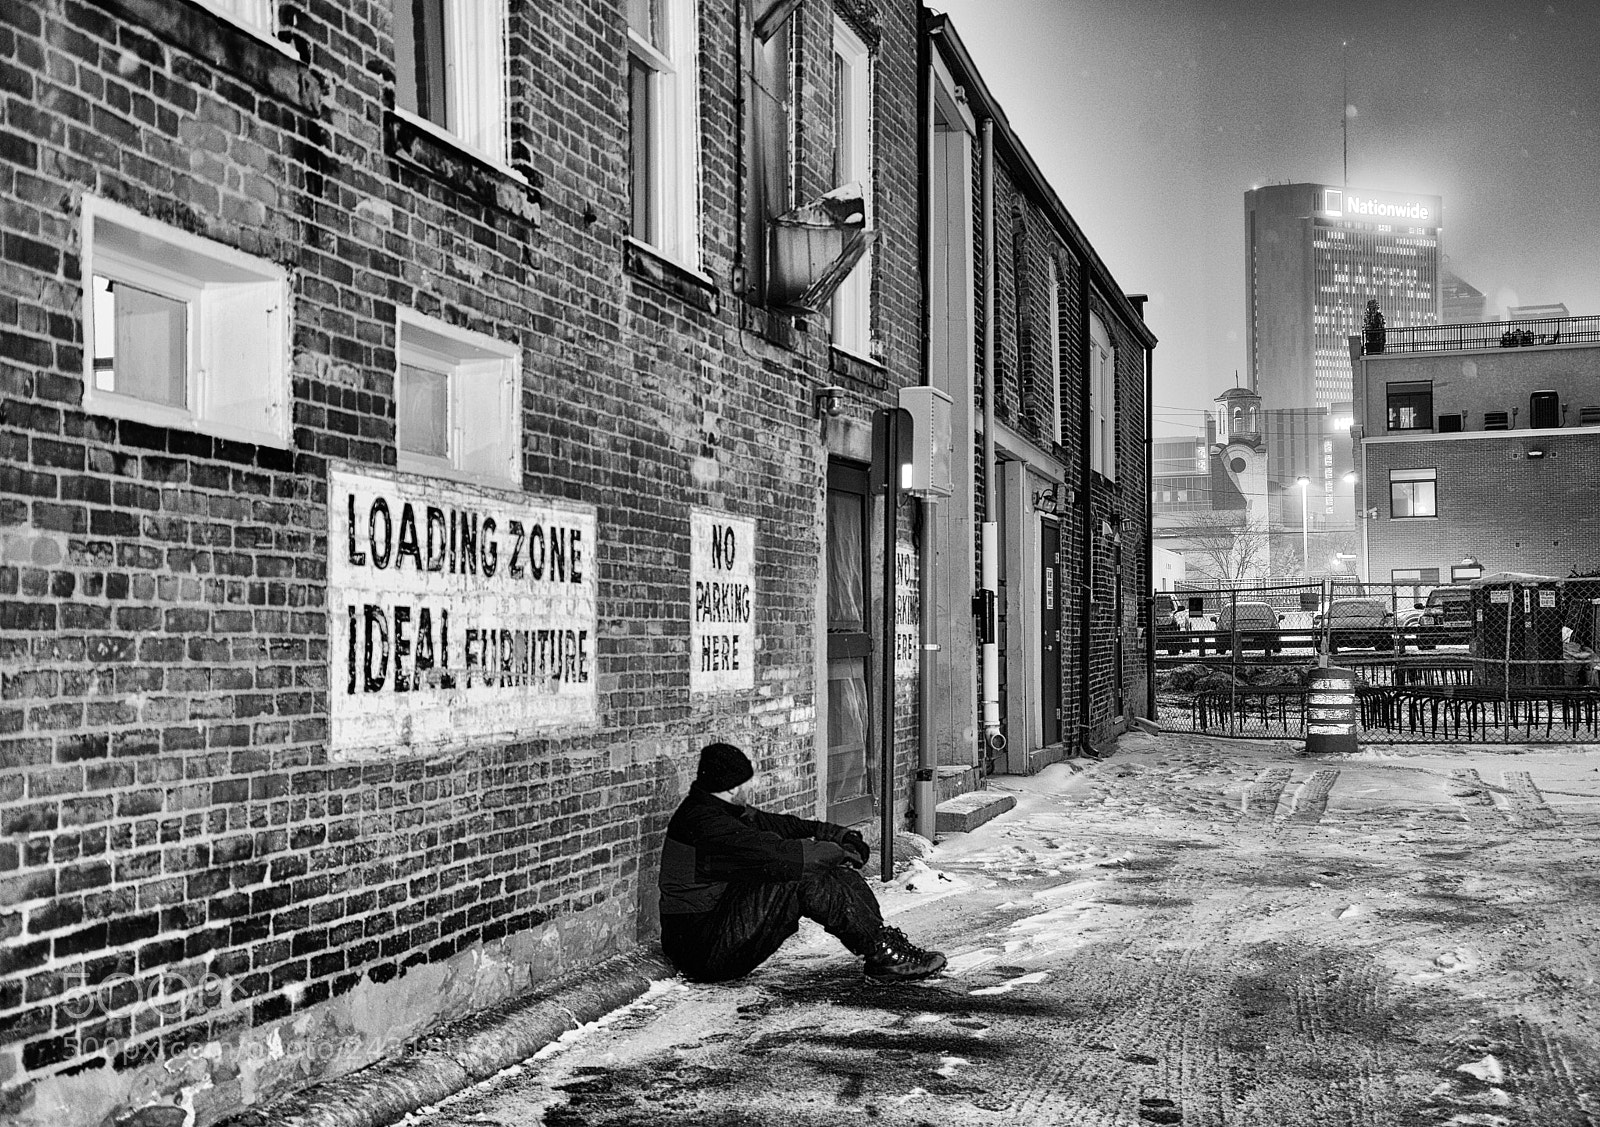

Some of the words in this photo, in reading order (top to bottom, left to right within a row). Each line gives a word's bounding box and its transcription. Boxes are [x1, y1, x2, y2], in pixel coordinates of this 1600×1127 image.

[1347, 196, 1428, 219] Nationwide
[1334, 263, 1417, 298] HAPPY
[1313, 304, 1437, 343] HOLAYS
[348, 494, 497, 578] LOADING
[508, 520, 582, 584] ZONE
[712, 524, 735, 571] NO
[897, 553, 911, 586] NO
[696, 581, 750, 623] PARKING
[896, 594, 918, 625] RKING
[347, 604, 456, 695] IDEAL
[465, 629, 588, 688] FURNITURE
[701, 634, 739, 672] HERE
[896, 633, 913, 660] ERE
